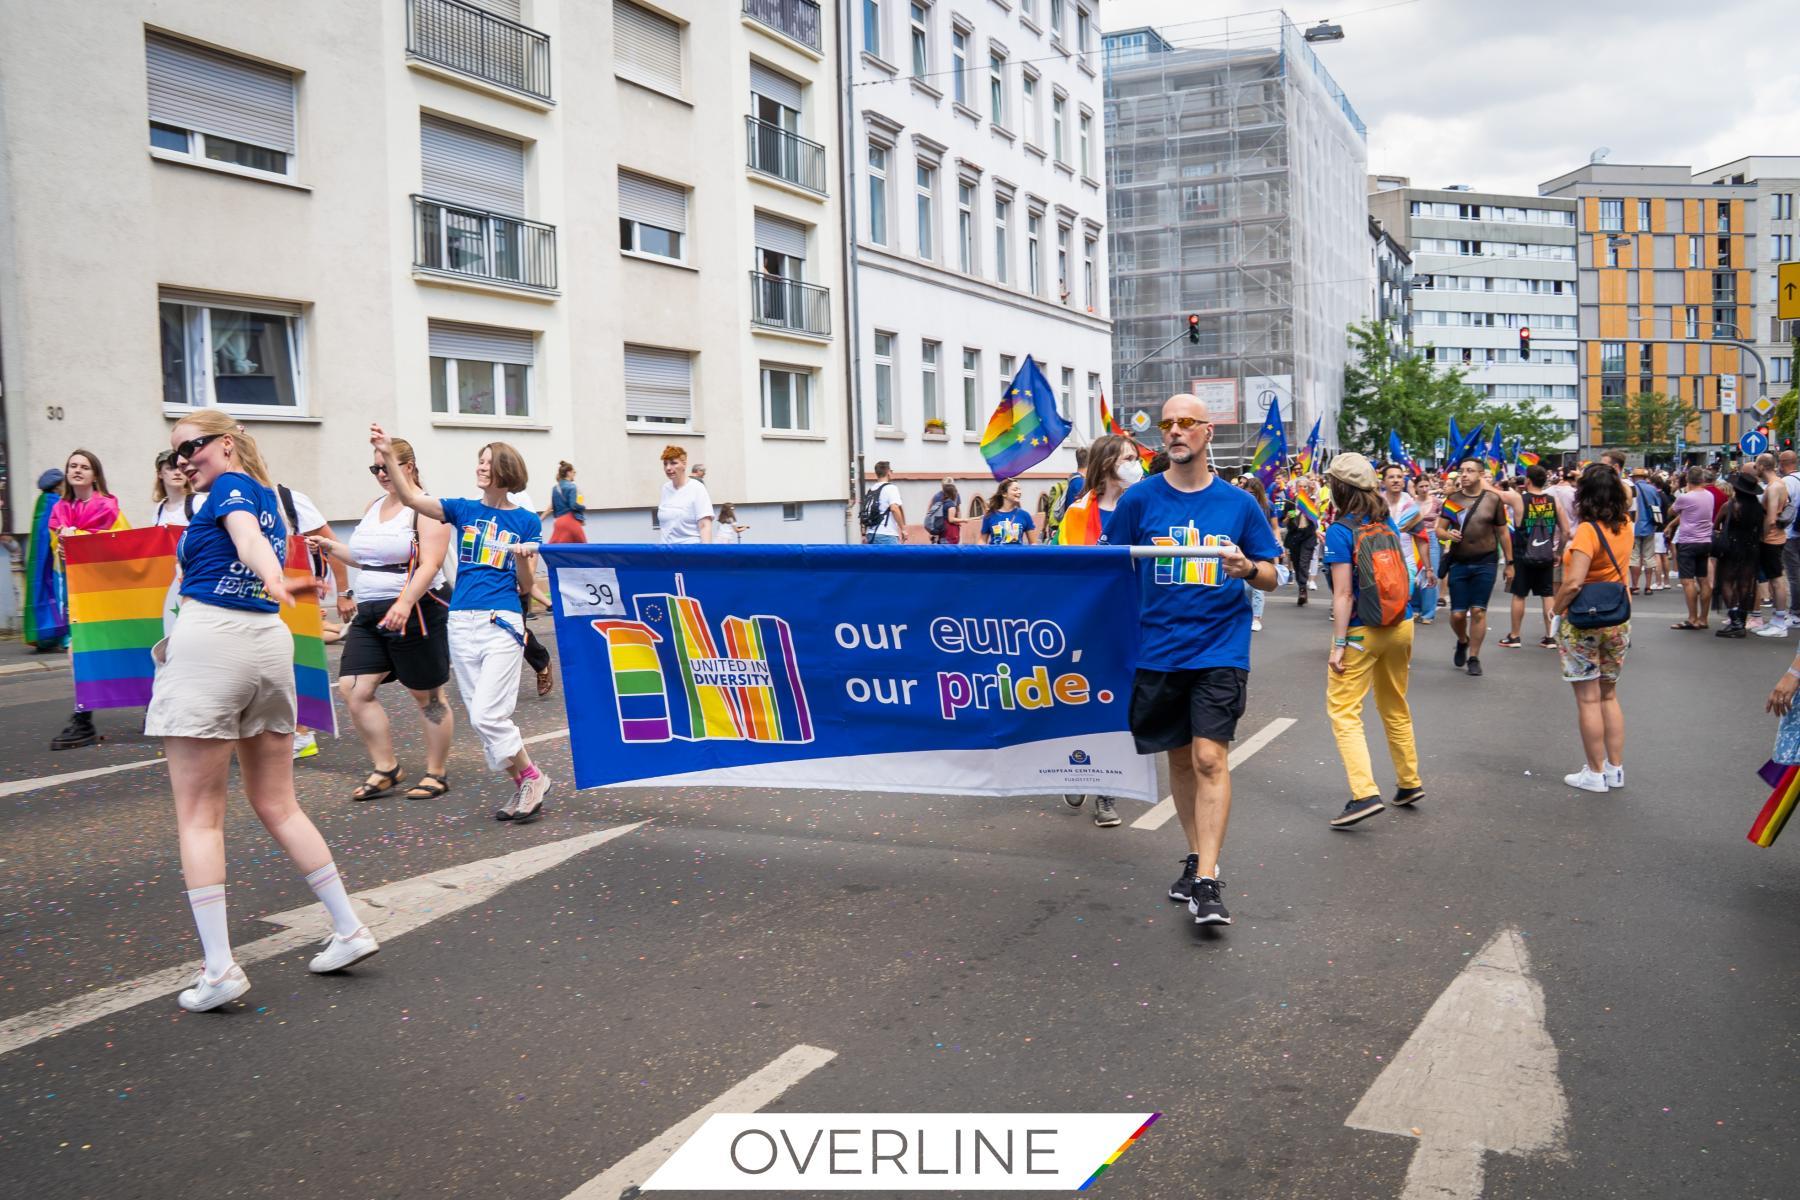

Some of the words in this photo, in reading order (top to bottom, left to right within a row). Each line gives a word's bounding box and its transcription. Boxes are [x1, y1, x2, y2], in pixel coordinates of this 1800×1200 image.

[47, 405, 65, 421] 30
[585, 583, 614, 606] 39
[834, 622, 907, 650] our
[929, 616, 1083, 663] euro,
[690, 660, 747, 672] UNITED
[751, 661, 768, 673] IN
[694, 673, 770, 686] DIVERSITY
[845, 677, 918, 705] our
[937, 663, 1114, 721] pride.
